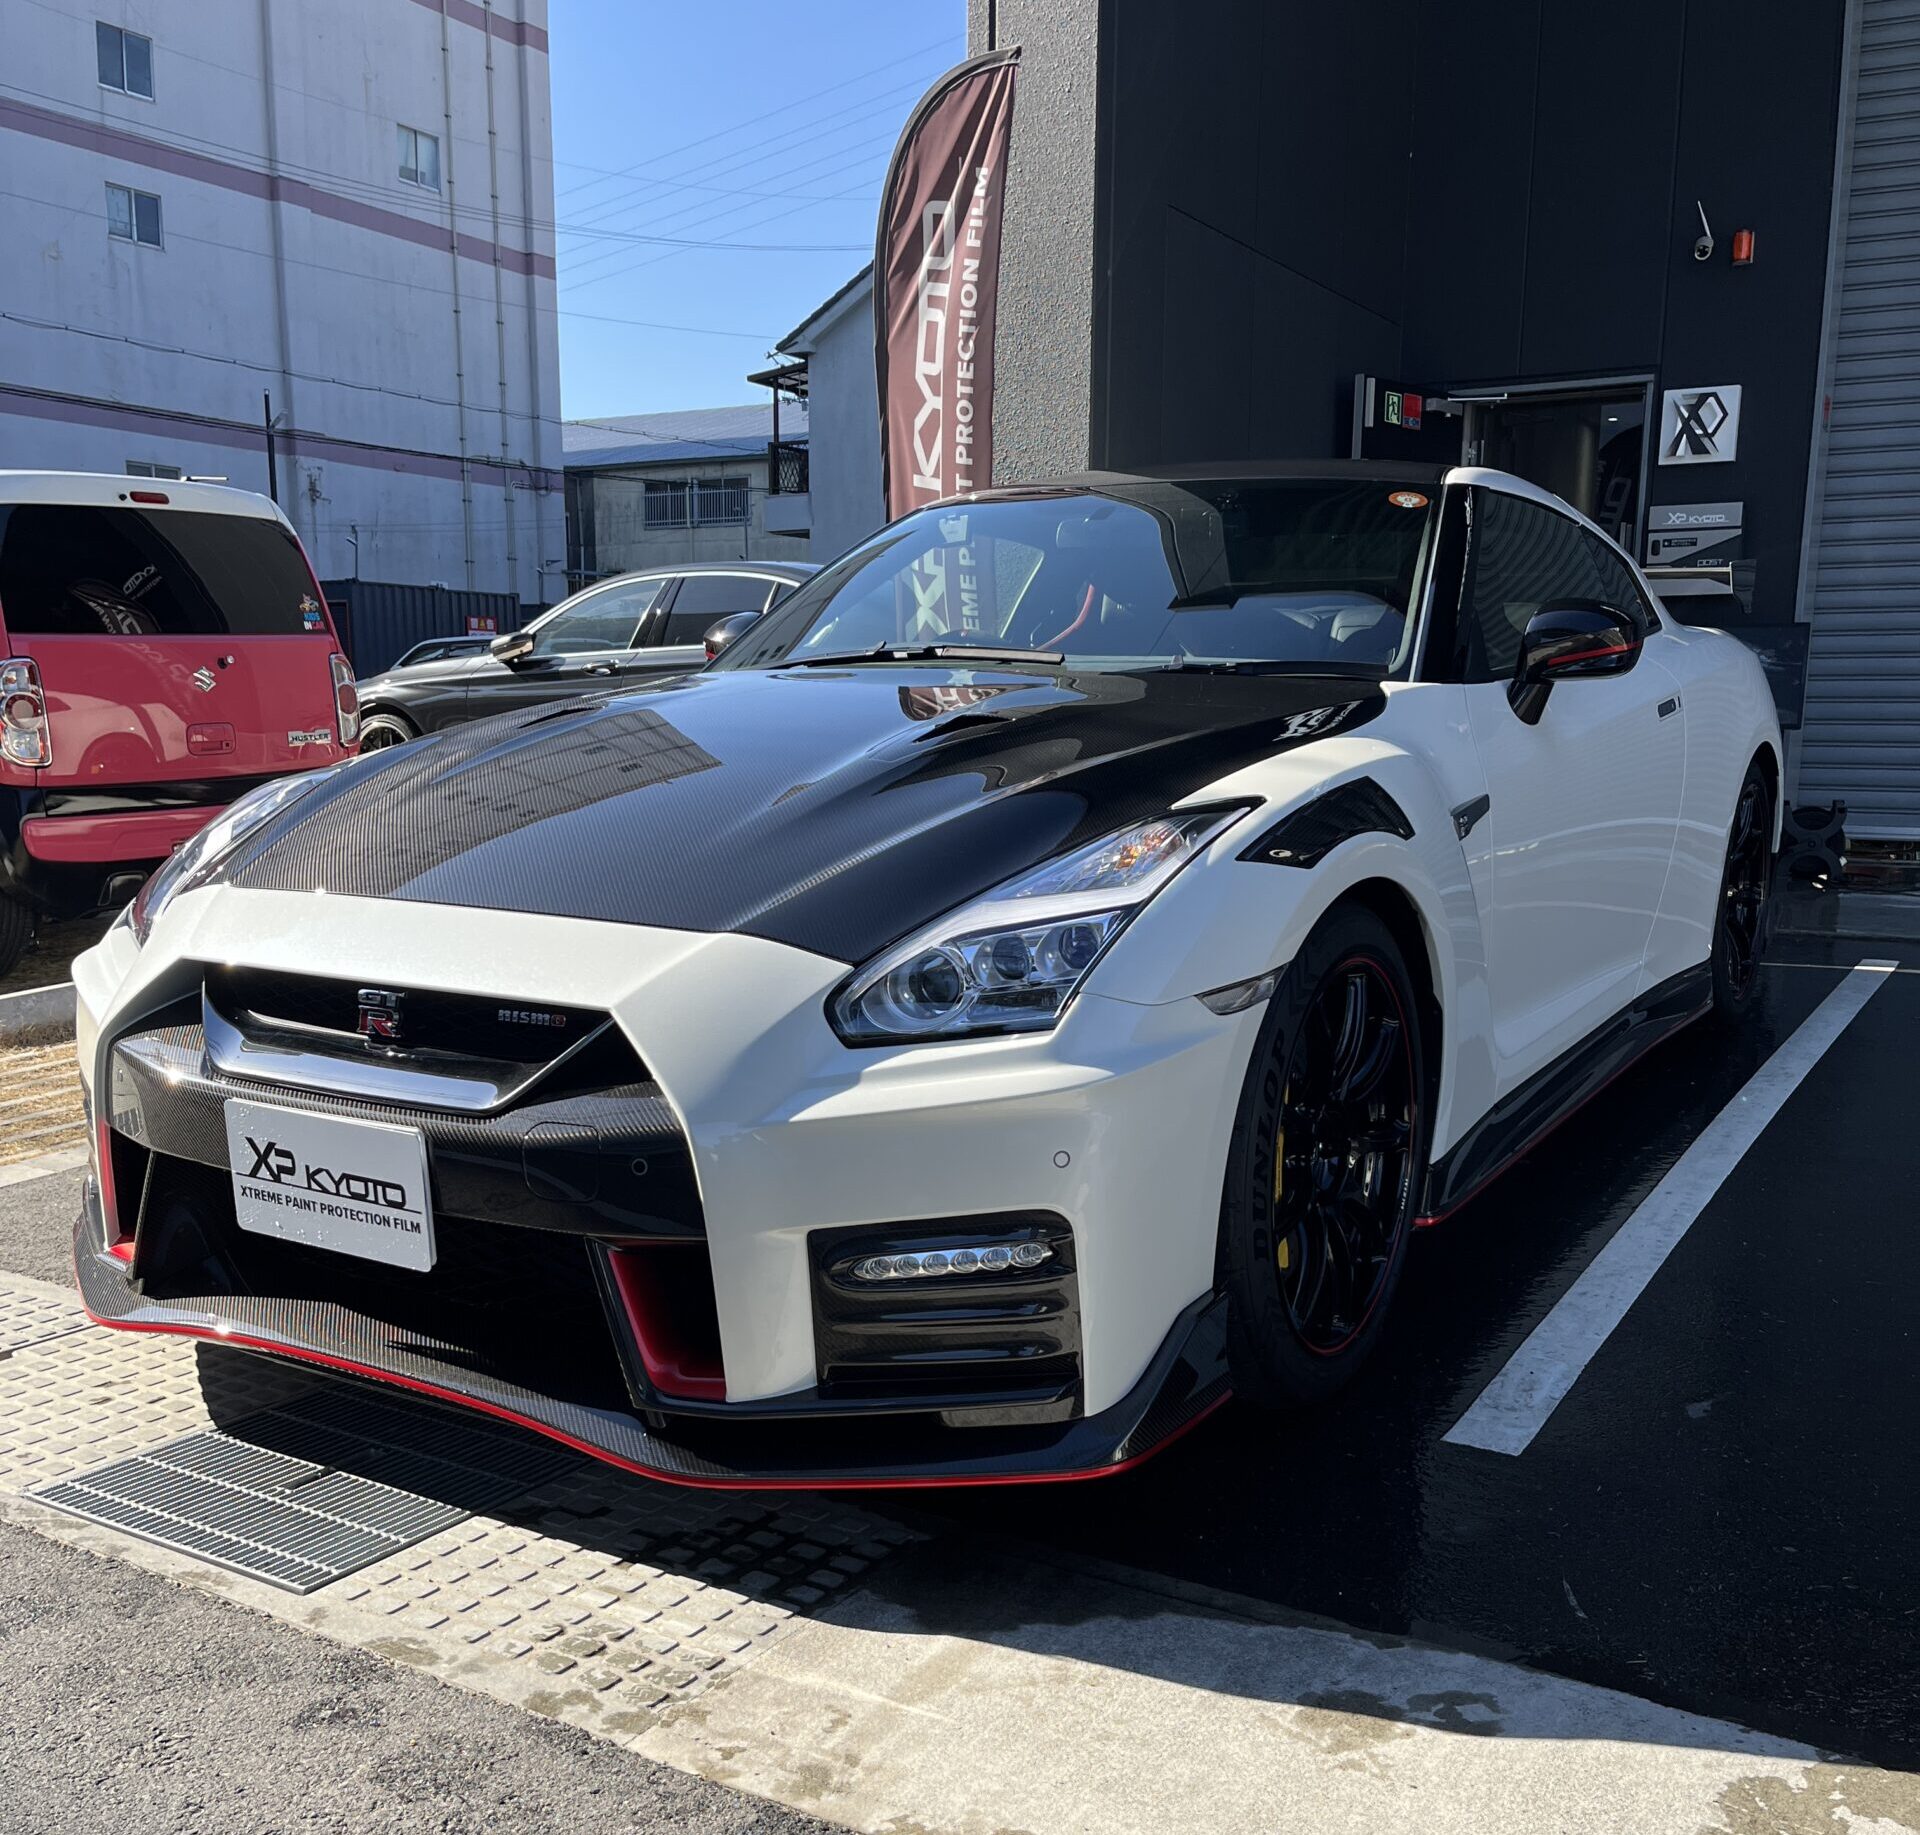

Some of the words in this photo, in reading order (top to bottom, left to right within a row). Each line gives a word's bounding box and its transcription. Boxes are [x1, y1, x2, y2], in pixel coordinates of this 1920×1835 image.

[966, 167, 989, 248] FILM
[913, 200, 955, 491] KYOTO
[955, 255, 980, 466] PROTECTION
[1668, 513, 1687, 524] XP
[1689, 514, 1725, 523] KYOTO
[291, 733, 329, 741] HUSTLER
[356, 1005, 404, 1038] R
[357, 988, 407, 1008] GT
[245, 1136, 296, 1183] XP
[305, 1164, 406, 1209] KYOTO
[1253, 1028, 1285, 1260] DUNLOP
[240, 1185, 284, 1205] XTREME
[286, 1195, 317, 1214] PAINT
[320, 1203, 391, 1228] PROTECTION
[393, 1217, 421, 1234] FILM
